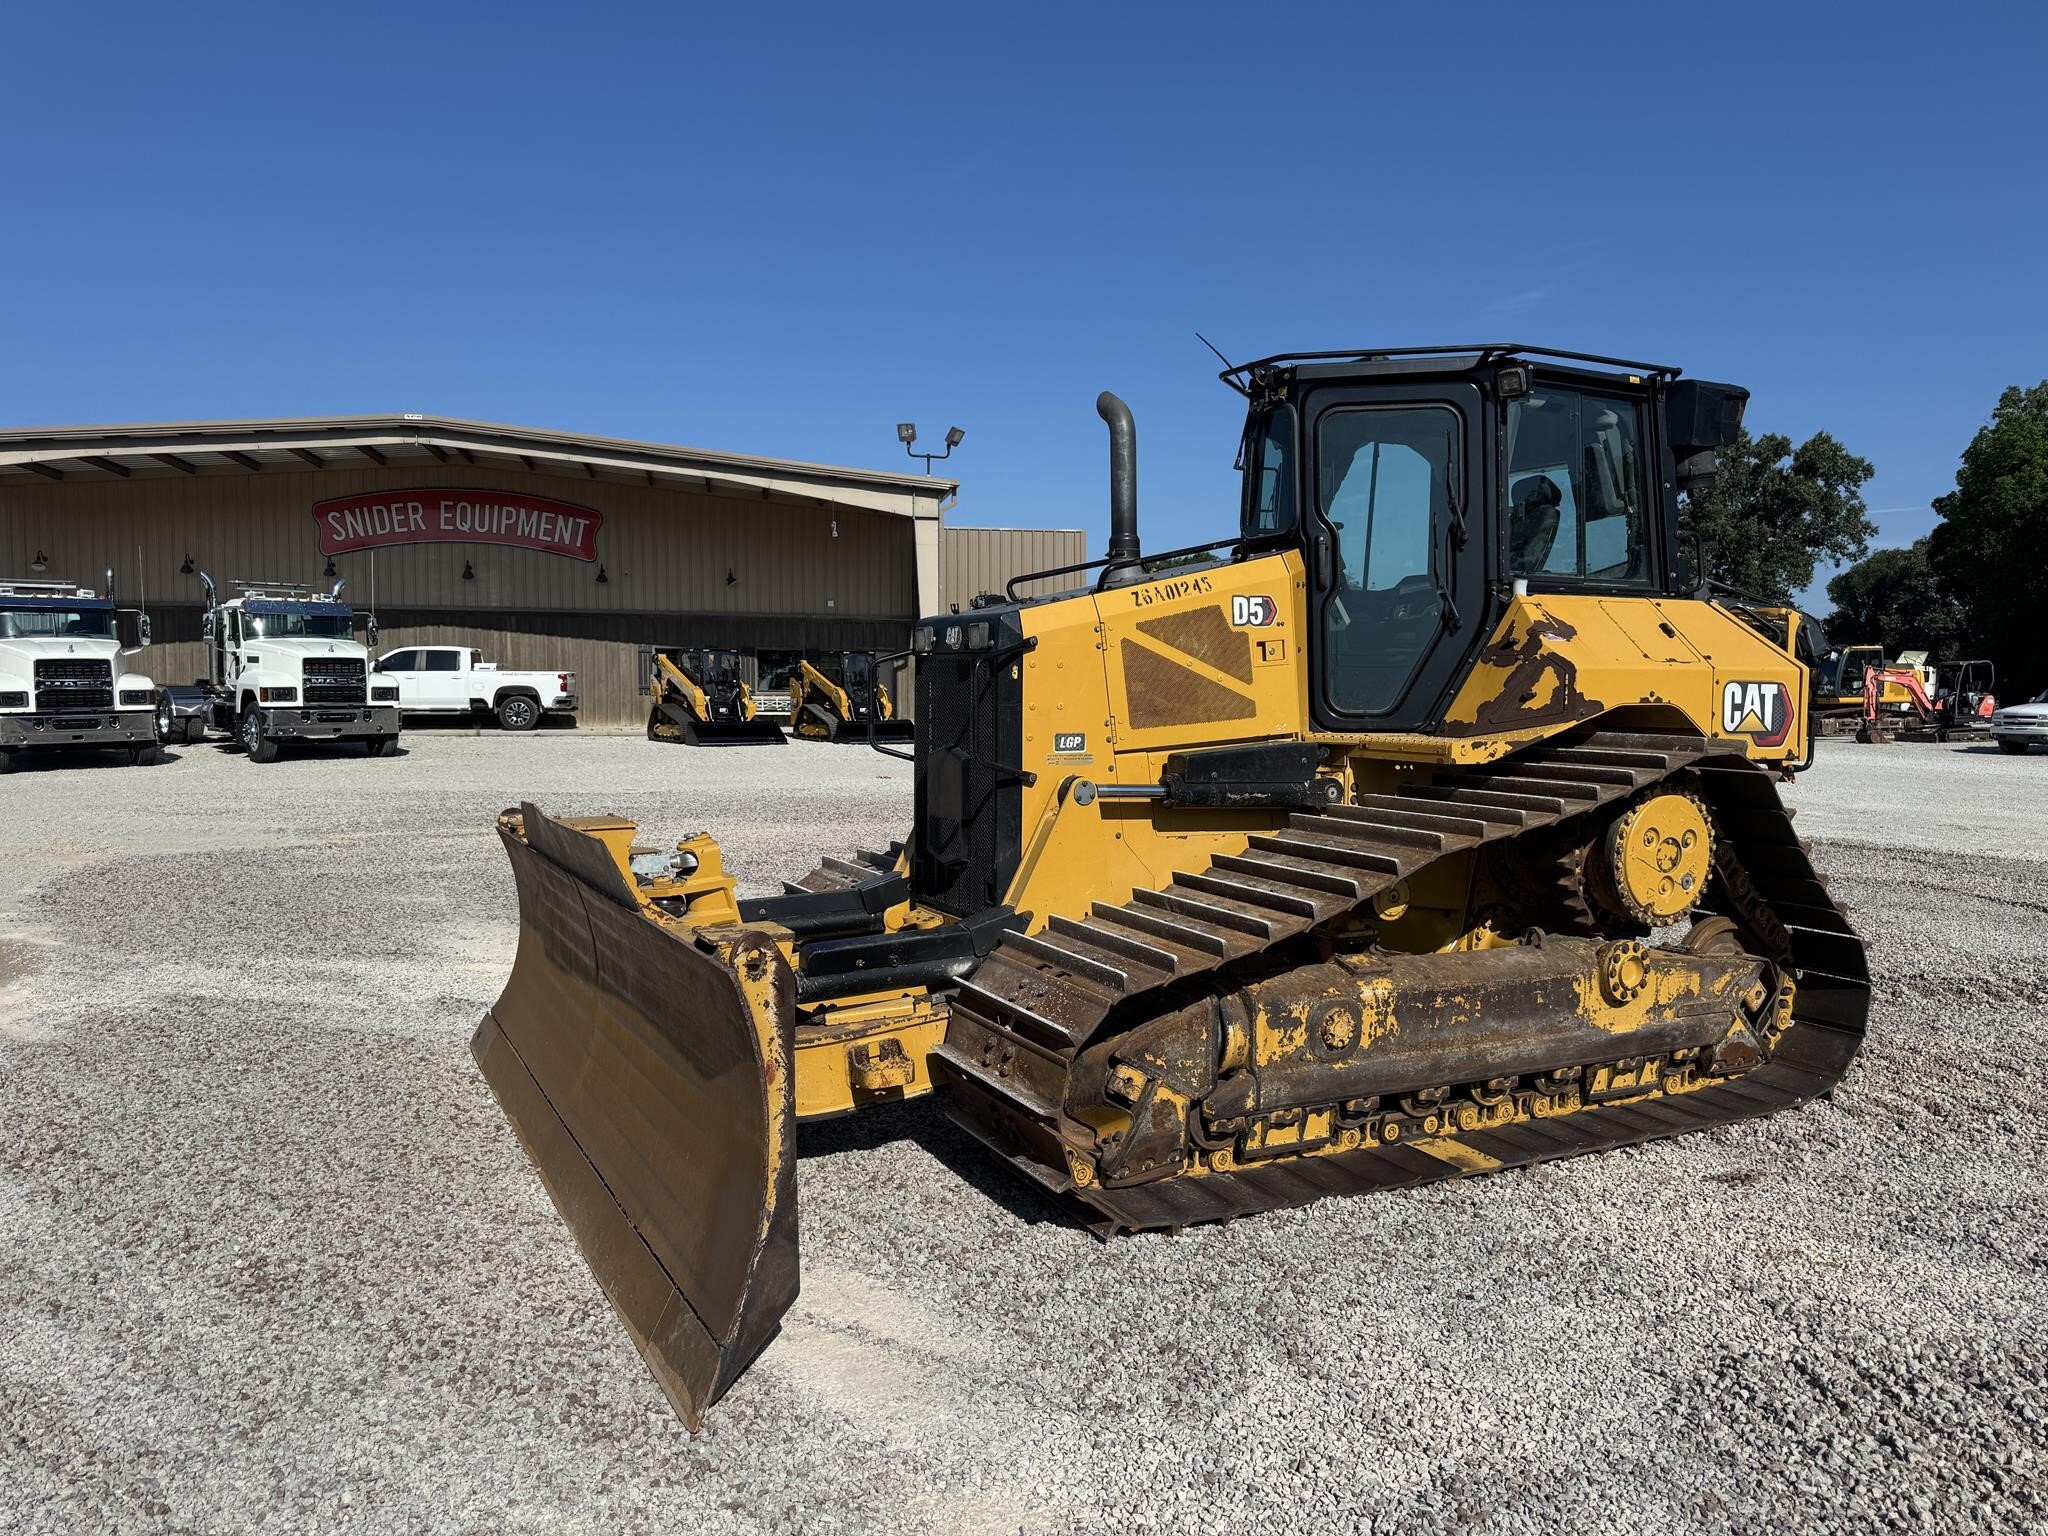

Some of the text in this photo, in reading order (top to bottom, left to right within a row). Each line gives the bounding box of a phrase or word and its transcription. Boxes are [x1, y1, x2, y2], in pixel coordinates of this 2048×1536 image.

[327, 500, 590, 547] SNIDER EQUIPMENT
[1232, 596, 1264, 626] D5
[946, 626, 961, 645] CAT
[1723, 682, 1778, 732] CAT
[1059, 736, 1082, 748] LGP
